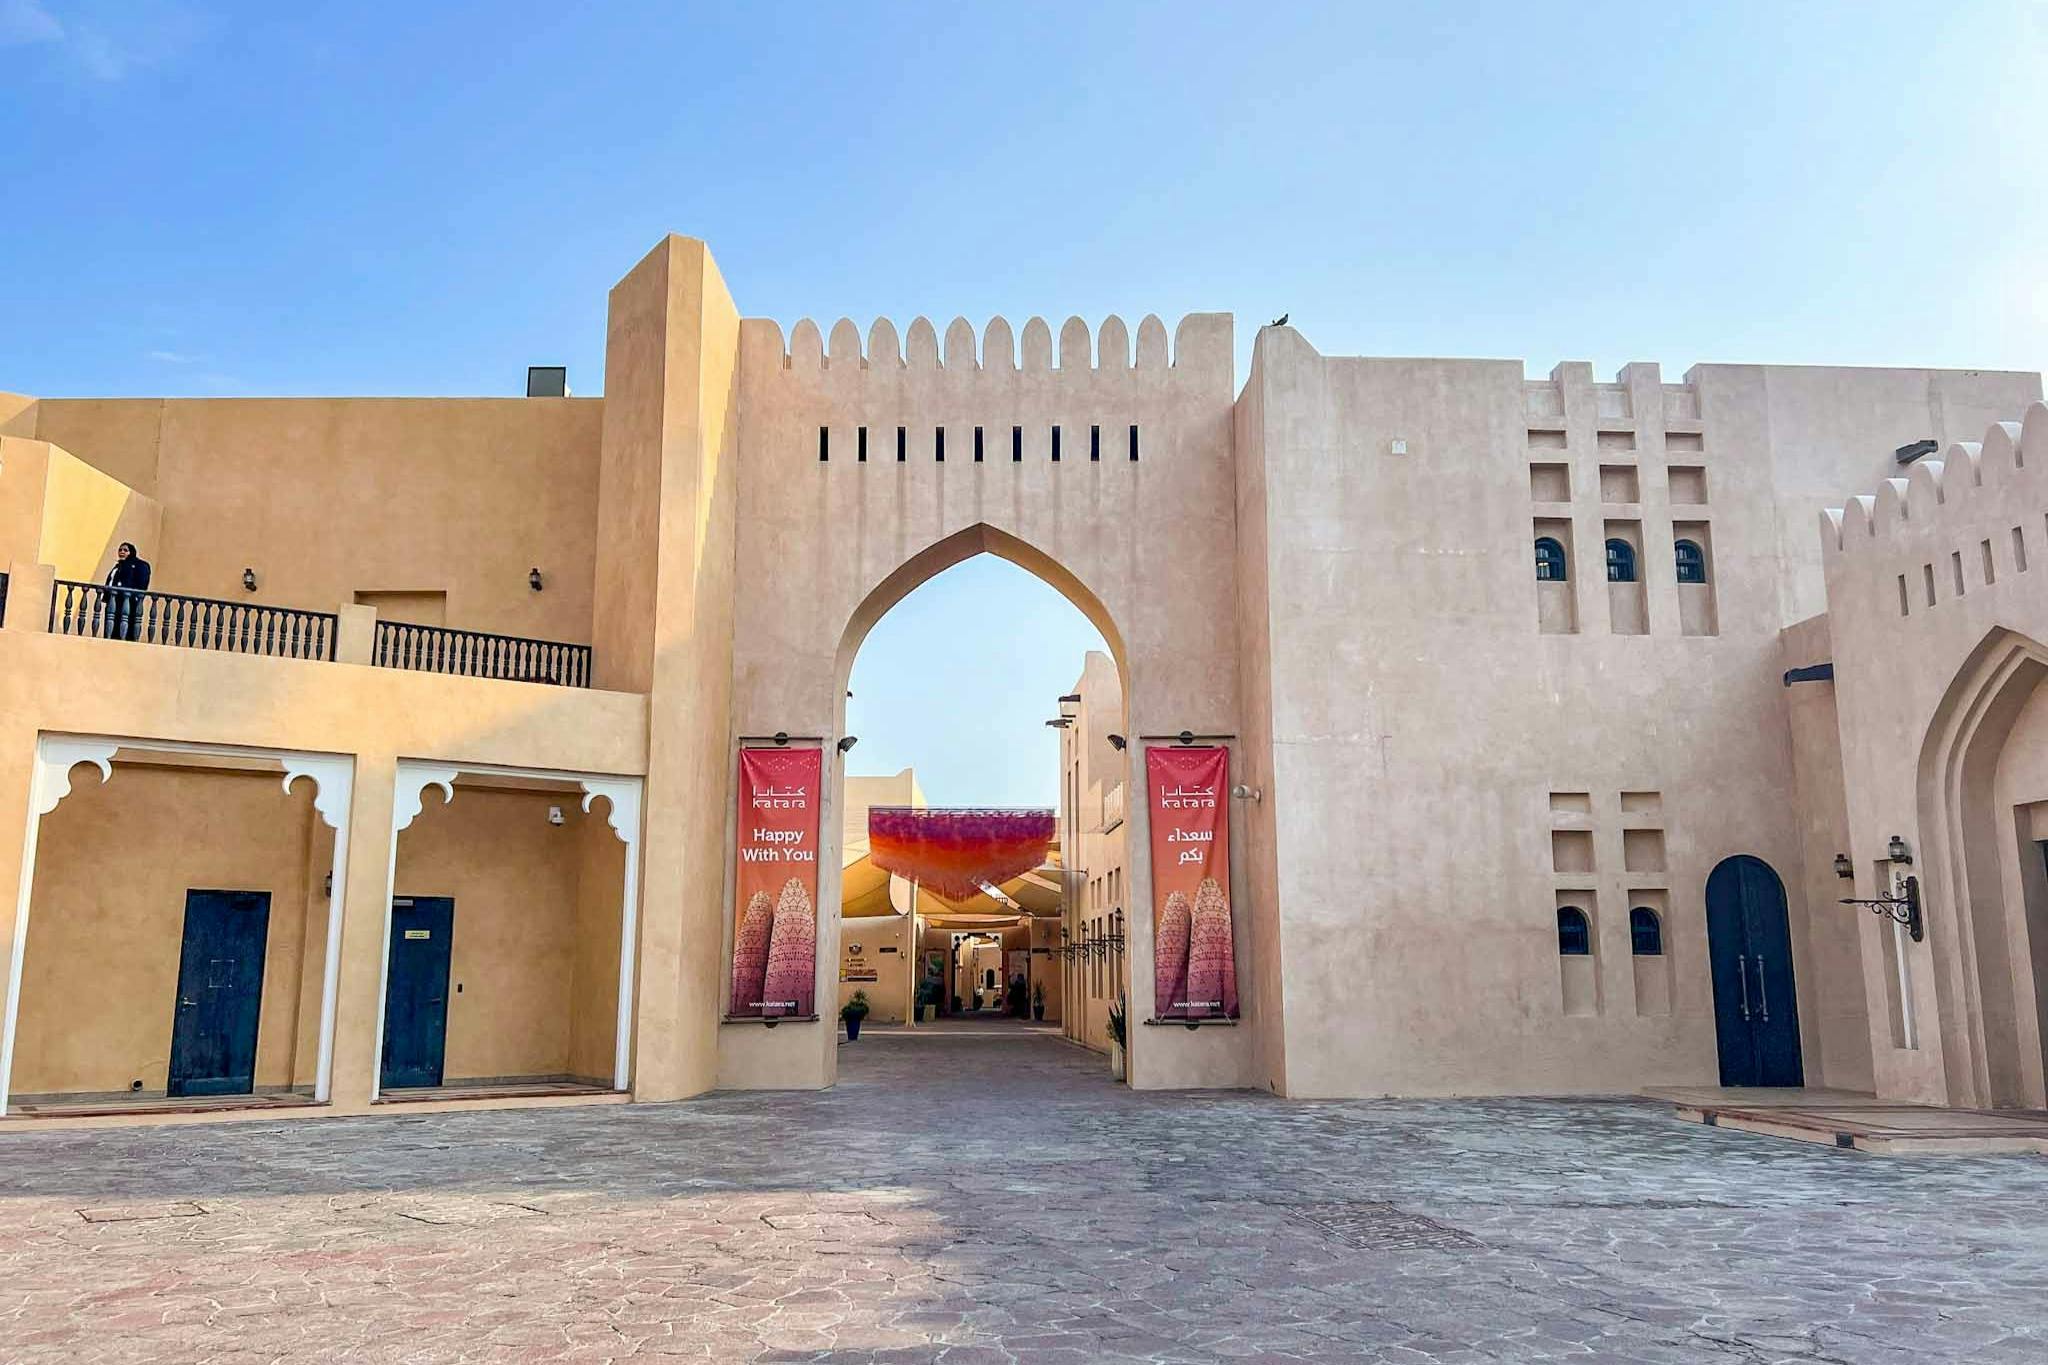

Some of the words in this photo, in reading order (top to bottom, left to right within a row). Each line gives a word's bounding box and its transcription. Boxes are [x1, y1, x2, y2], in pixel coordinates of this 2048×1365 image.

[752, 797, 806, 809] katara
[1161, 797, 1215, 809] katara
[753, 828, 804, 845] Happy
[1168, 828, 1213, 842] سعداء
[742, 847, 779, 862] With
[783, 847, 814, 862] You
[1178, 847, 1203, 865] بكم
